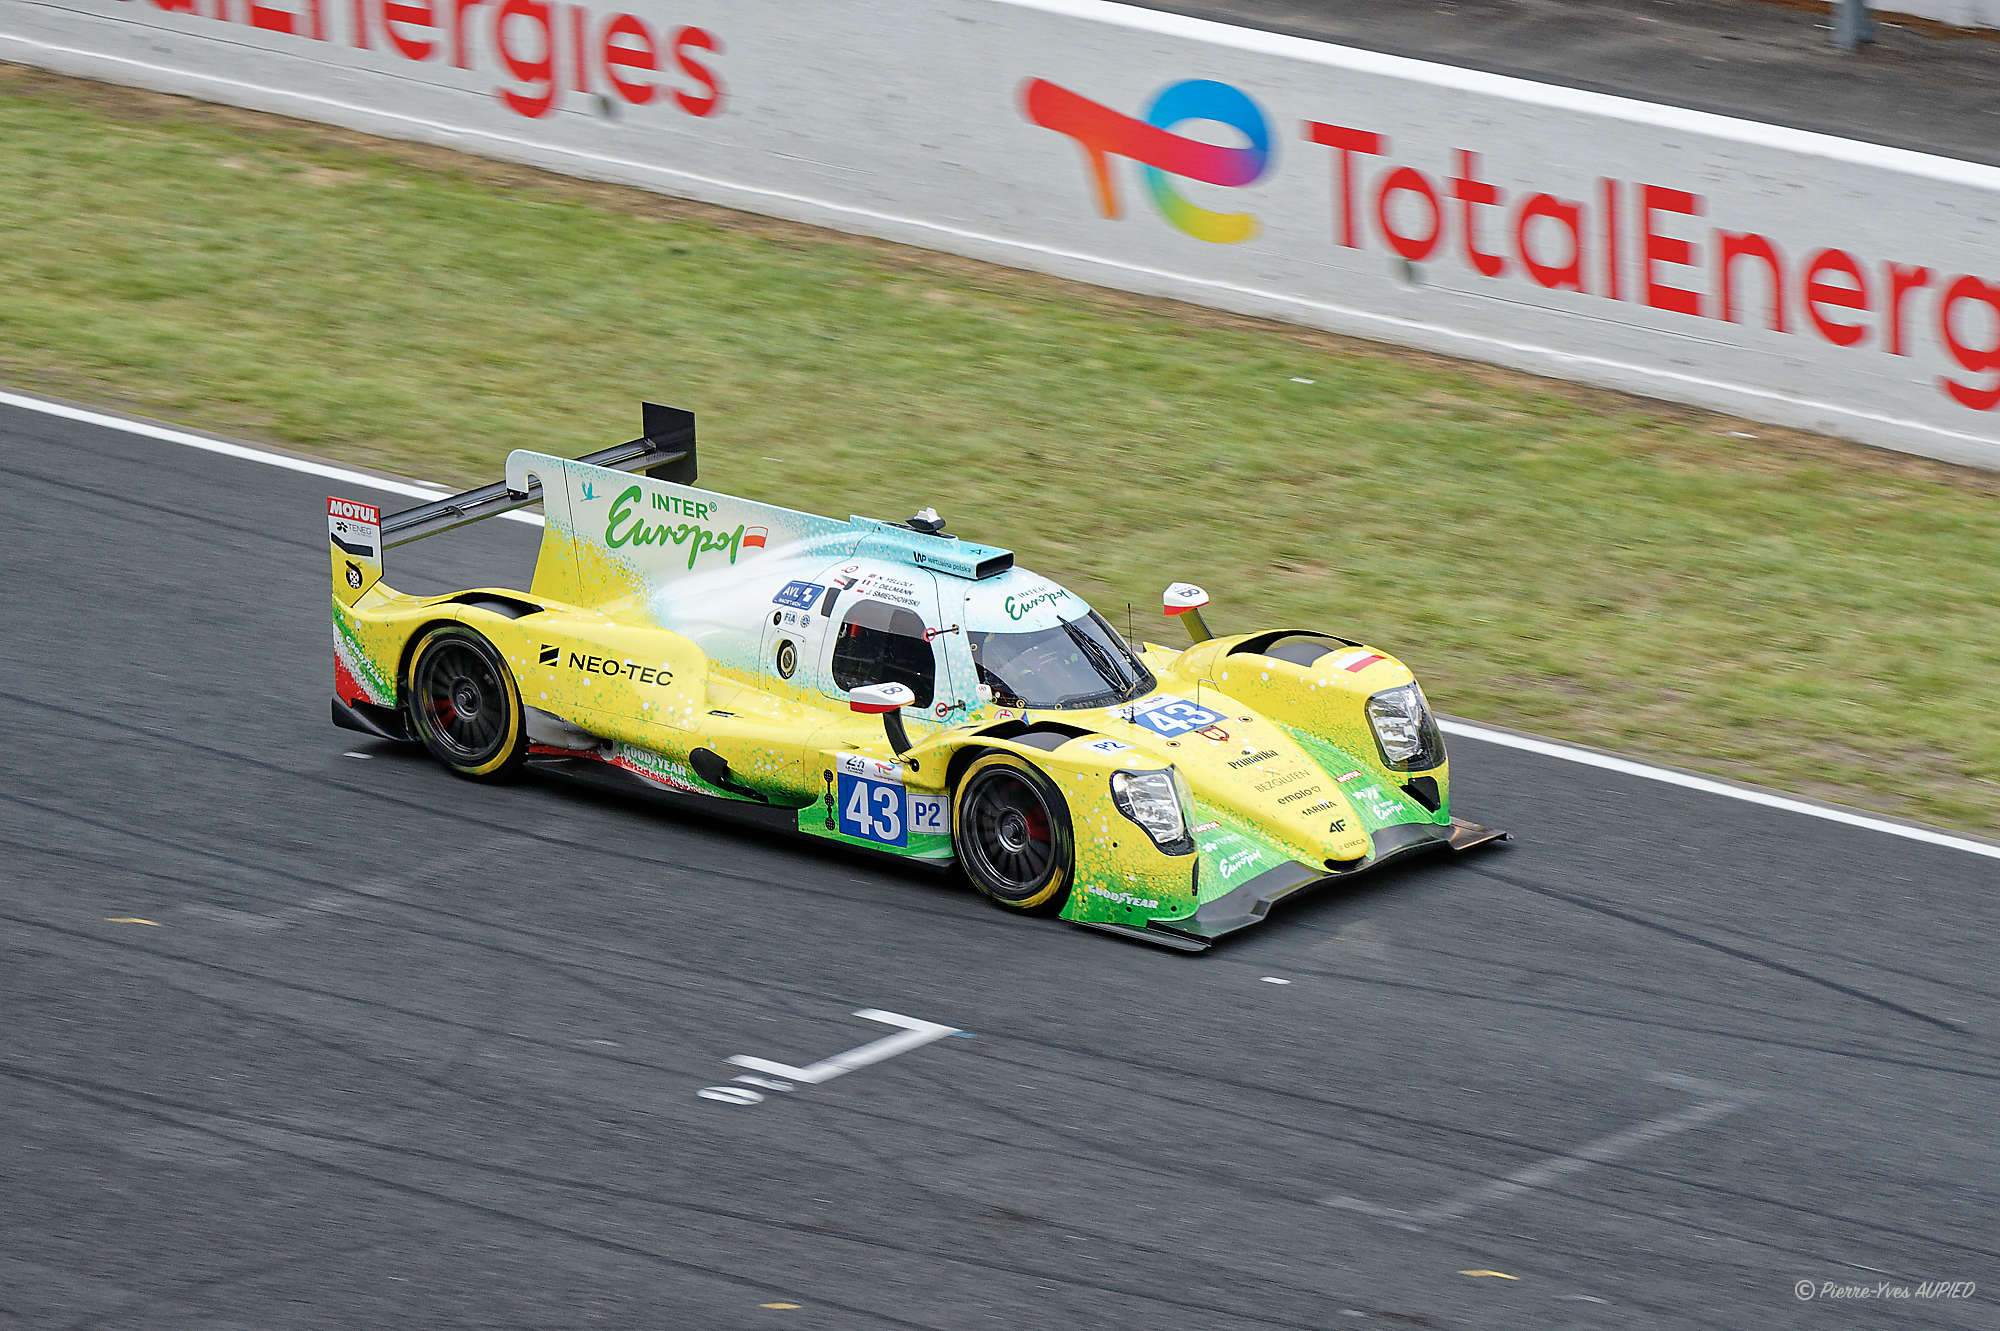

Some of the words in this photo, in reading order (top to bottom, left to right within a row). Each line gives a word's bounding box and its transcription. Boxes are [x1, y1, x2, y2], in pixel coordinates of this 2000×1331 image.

[330, 500, 377, 523] MOTUL
[606, 485, 745, 569] Europol
[783, 586, 799, 599] AVL
[1005, 589, 1071, 621] Europol
[569, 652, 674, 687] NEO-TEC
[1145, 703, 1216, 732] 43
[623, 743, 687, 776] GOODYEAR
[1094, 741, 1126, 752] P2
[1228, 749, 1279, 770] Primavika
[1254, 769, 1310, 793] BEZGLUTEN
[846, 781, 902, 842] 43
[914, 801, 940, 828] P2
[1087, 883, 1159, 910] GOODYEAR
